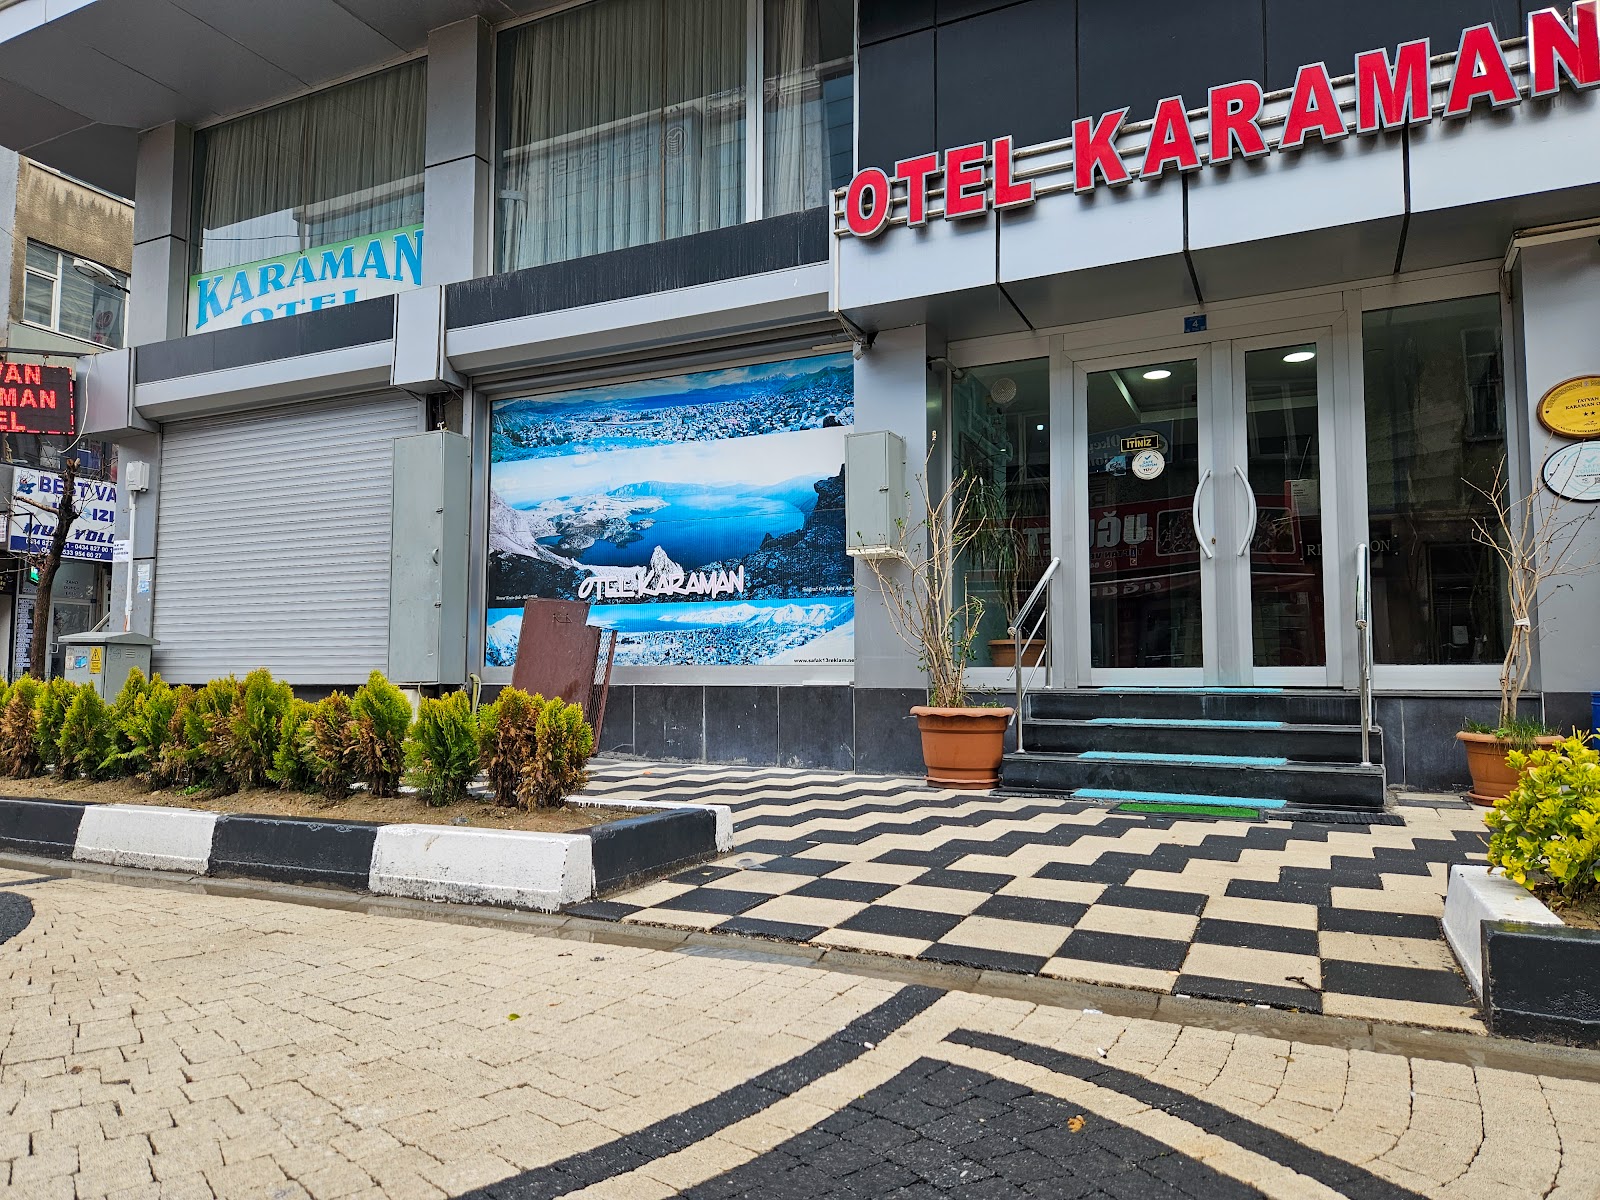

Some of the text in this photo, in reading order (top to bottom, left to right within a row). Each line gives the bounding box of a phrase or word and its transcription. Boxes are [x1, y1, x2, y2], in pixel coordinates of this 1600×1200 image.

[845, 0, 1600, 240] OTEL KARAMAN
[196, 229, 424, 330] KARAMAN
[1191, 319, 1200, 328] 4
[578, 565, 744, 600] OTEL KARAMAN
